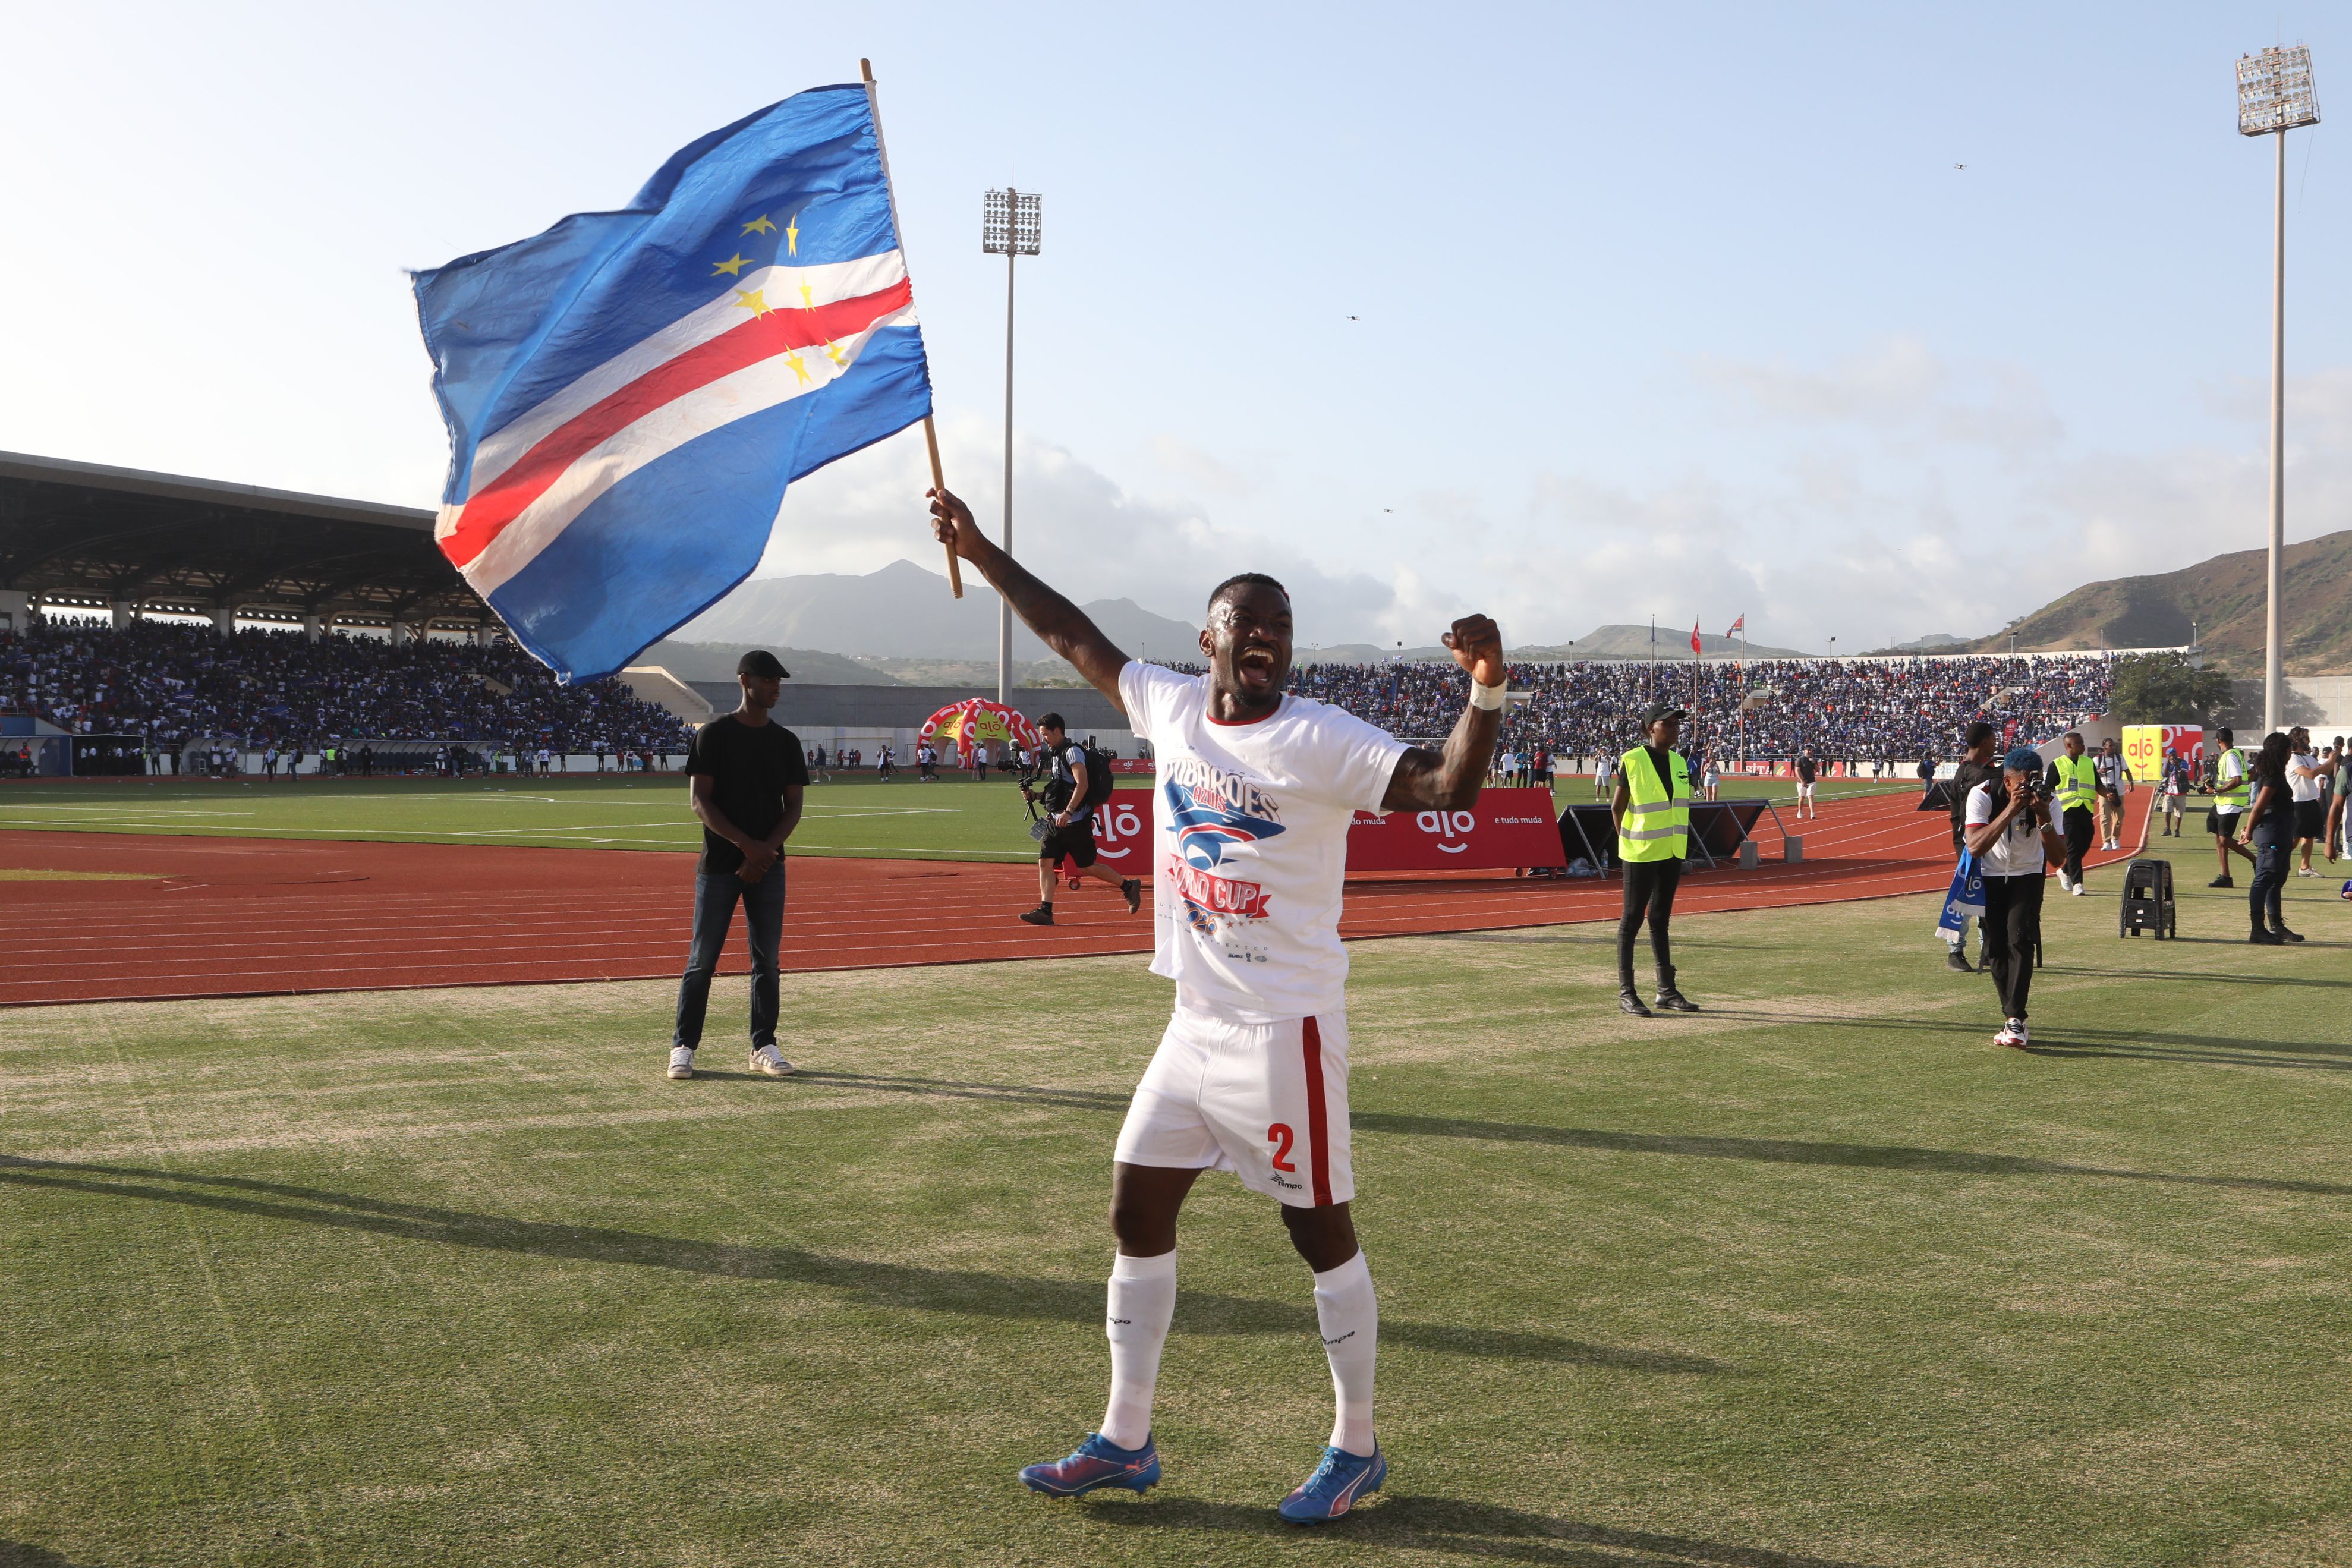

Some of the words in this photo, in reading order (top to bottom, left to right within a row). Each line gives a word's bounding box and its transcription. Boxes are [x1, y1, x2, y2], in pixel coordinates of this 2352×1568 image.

[1363, 817, 1386, 826] muda
[1501, 816, 1519, 824] tudo
[1520, 816, 1542, 824] muda
[1213, 879, 1257, 911] CUP
[1268, 1123, 1295, 1173] 2
[1277, 1180, 1302, 1189] tempo
